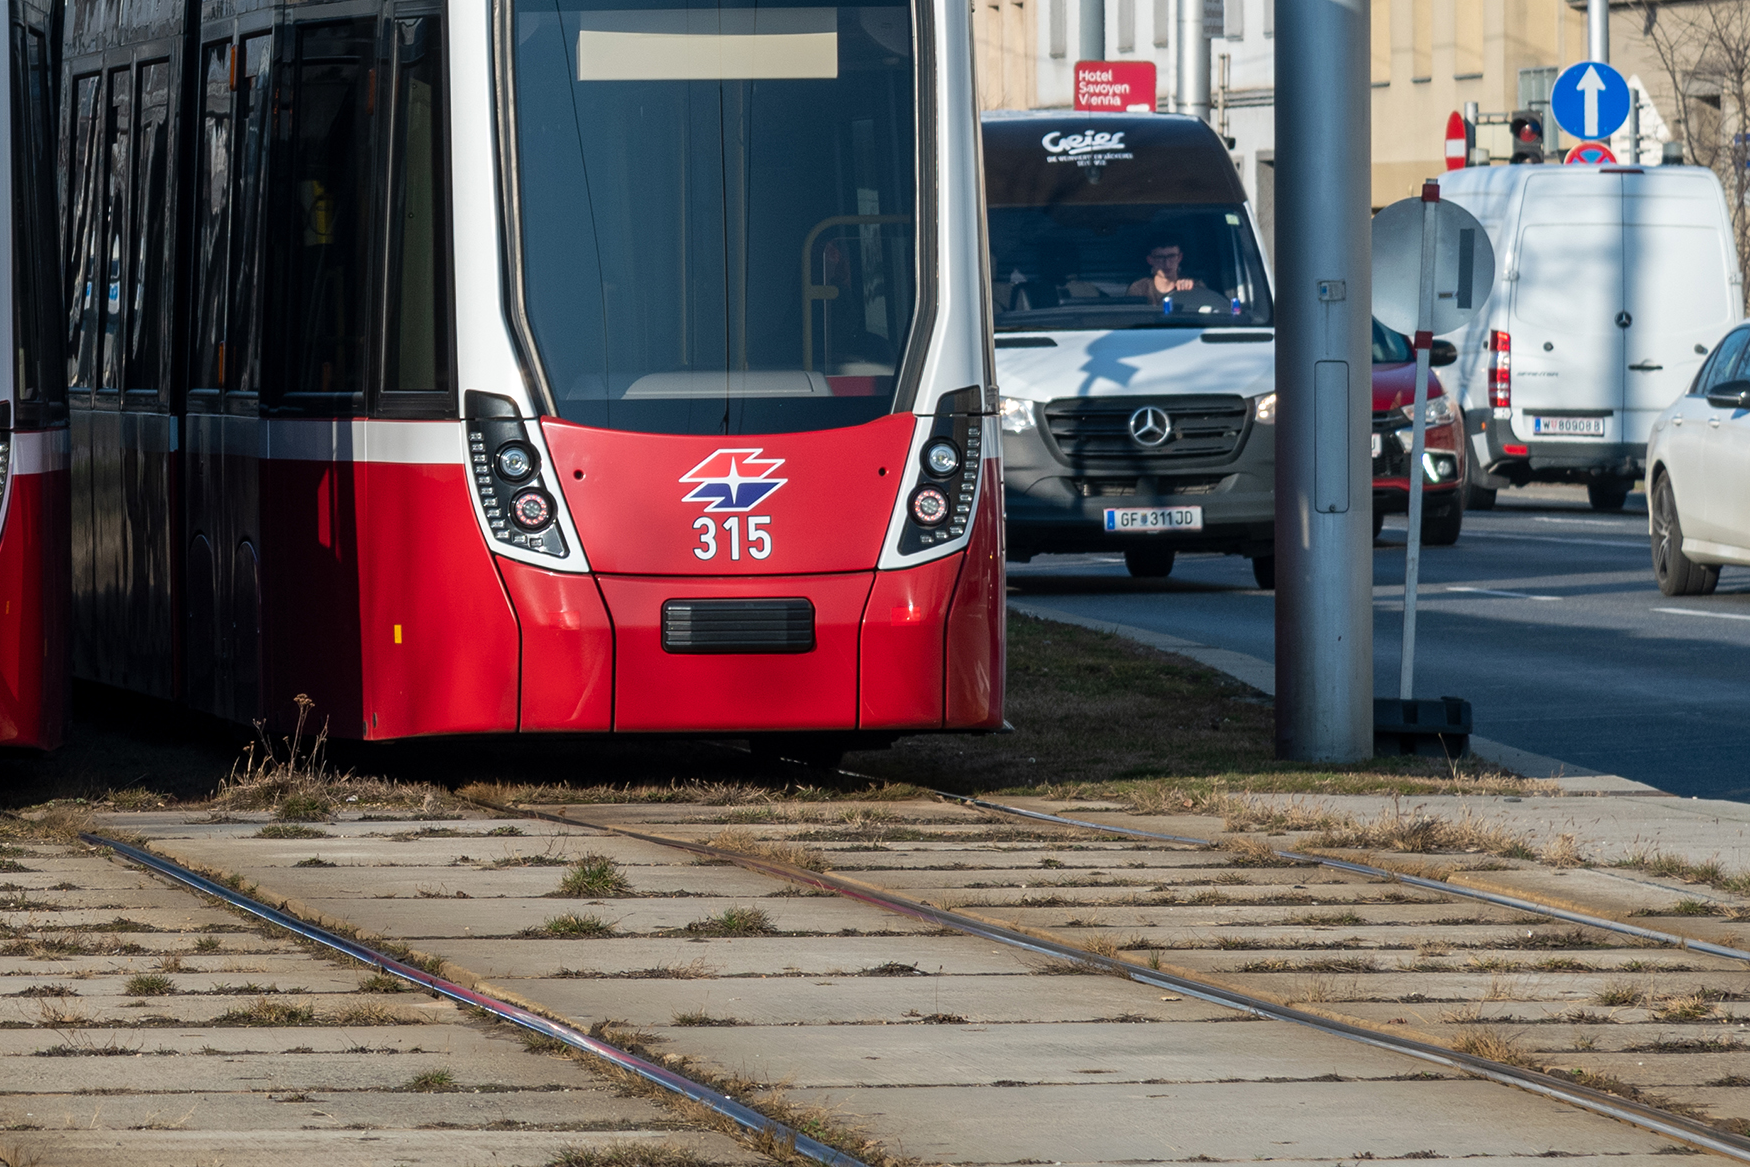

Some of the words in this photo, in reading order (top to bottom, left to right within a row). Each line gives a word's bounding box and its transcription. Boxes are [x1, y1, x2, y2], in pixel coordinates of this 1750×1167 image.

[1078, 70, 1113, 82] Hotel
[1078, 82, 1130, 95] Savoyen
[1078, 93, 1121, 106] Vienna
[1041, 130, 1125, 154] Geier
[1120, 512, 1138, 527] GF
[692, 515, 773, 561] 315
